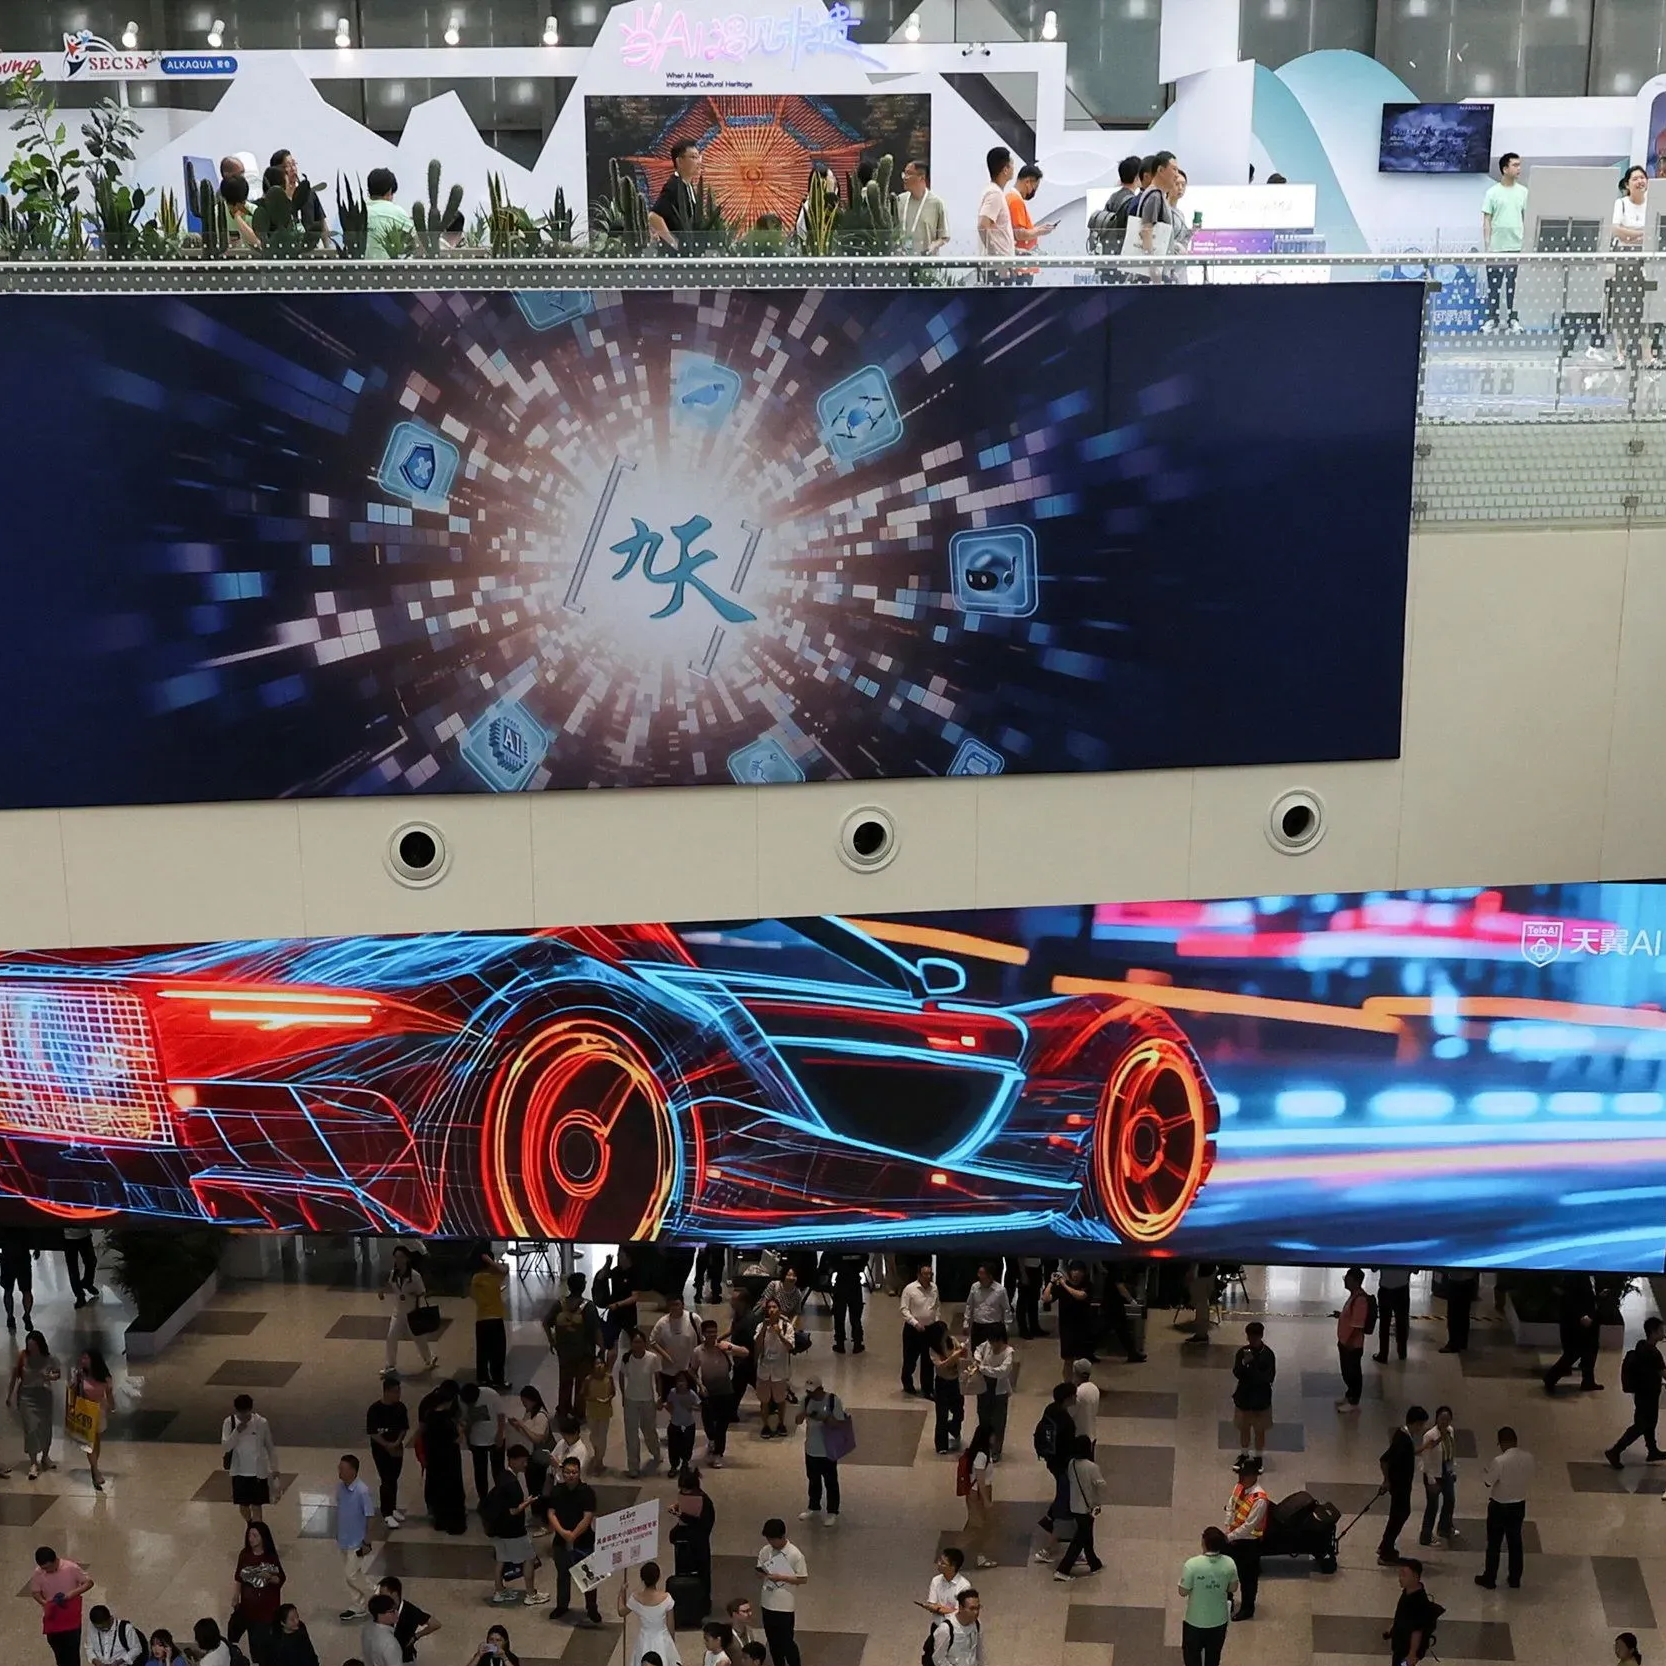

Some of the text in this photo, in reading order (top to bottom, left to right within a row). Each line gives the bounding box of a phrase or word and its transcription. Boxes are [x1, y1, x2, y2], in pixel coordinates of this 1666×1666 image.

[89, 61, 147, 76] SECSA
[167, 60, 213, 69] ALKAQUA
[1569, 928, 1662, 956] 天翼AI
